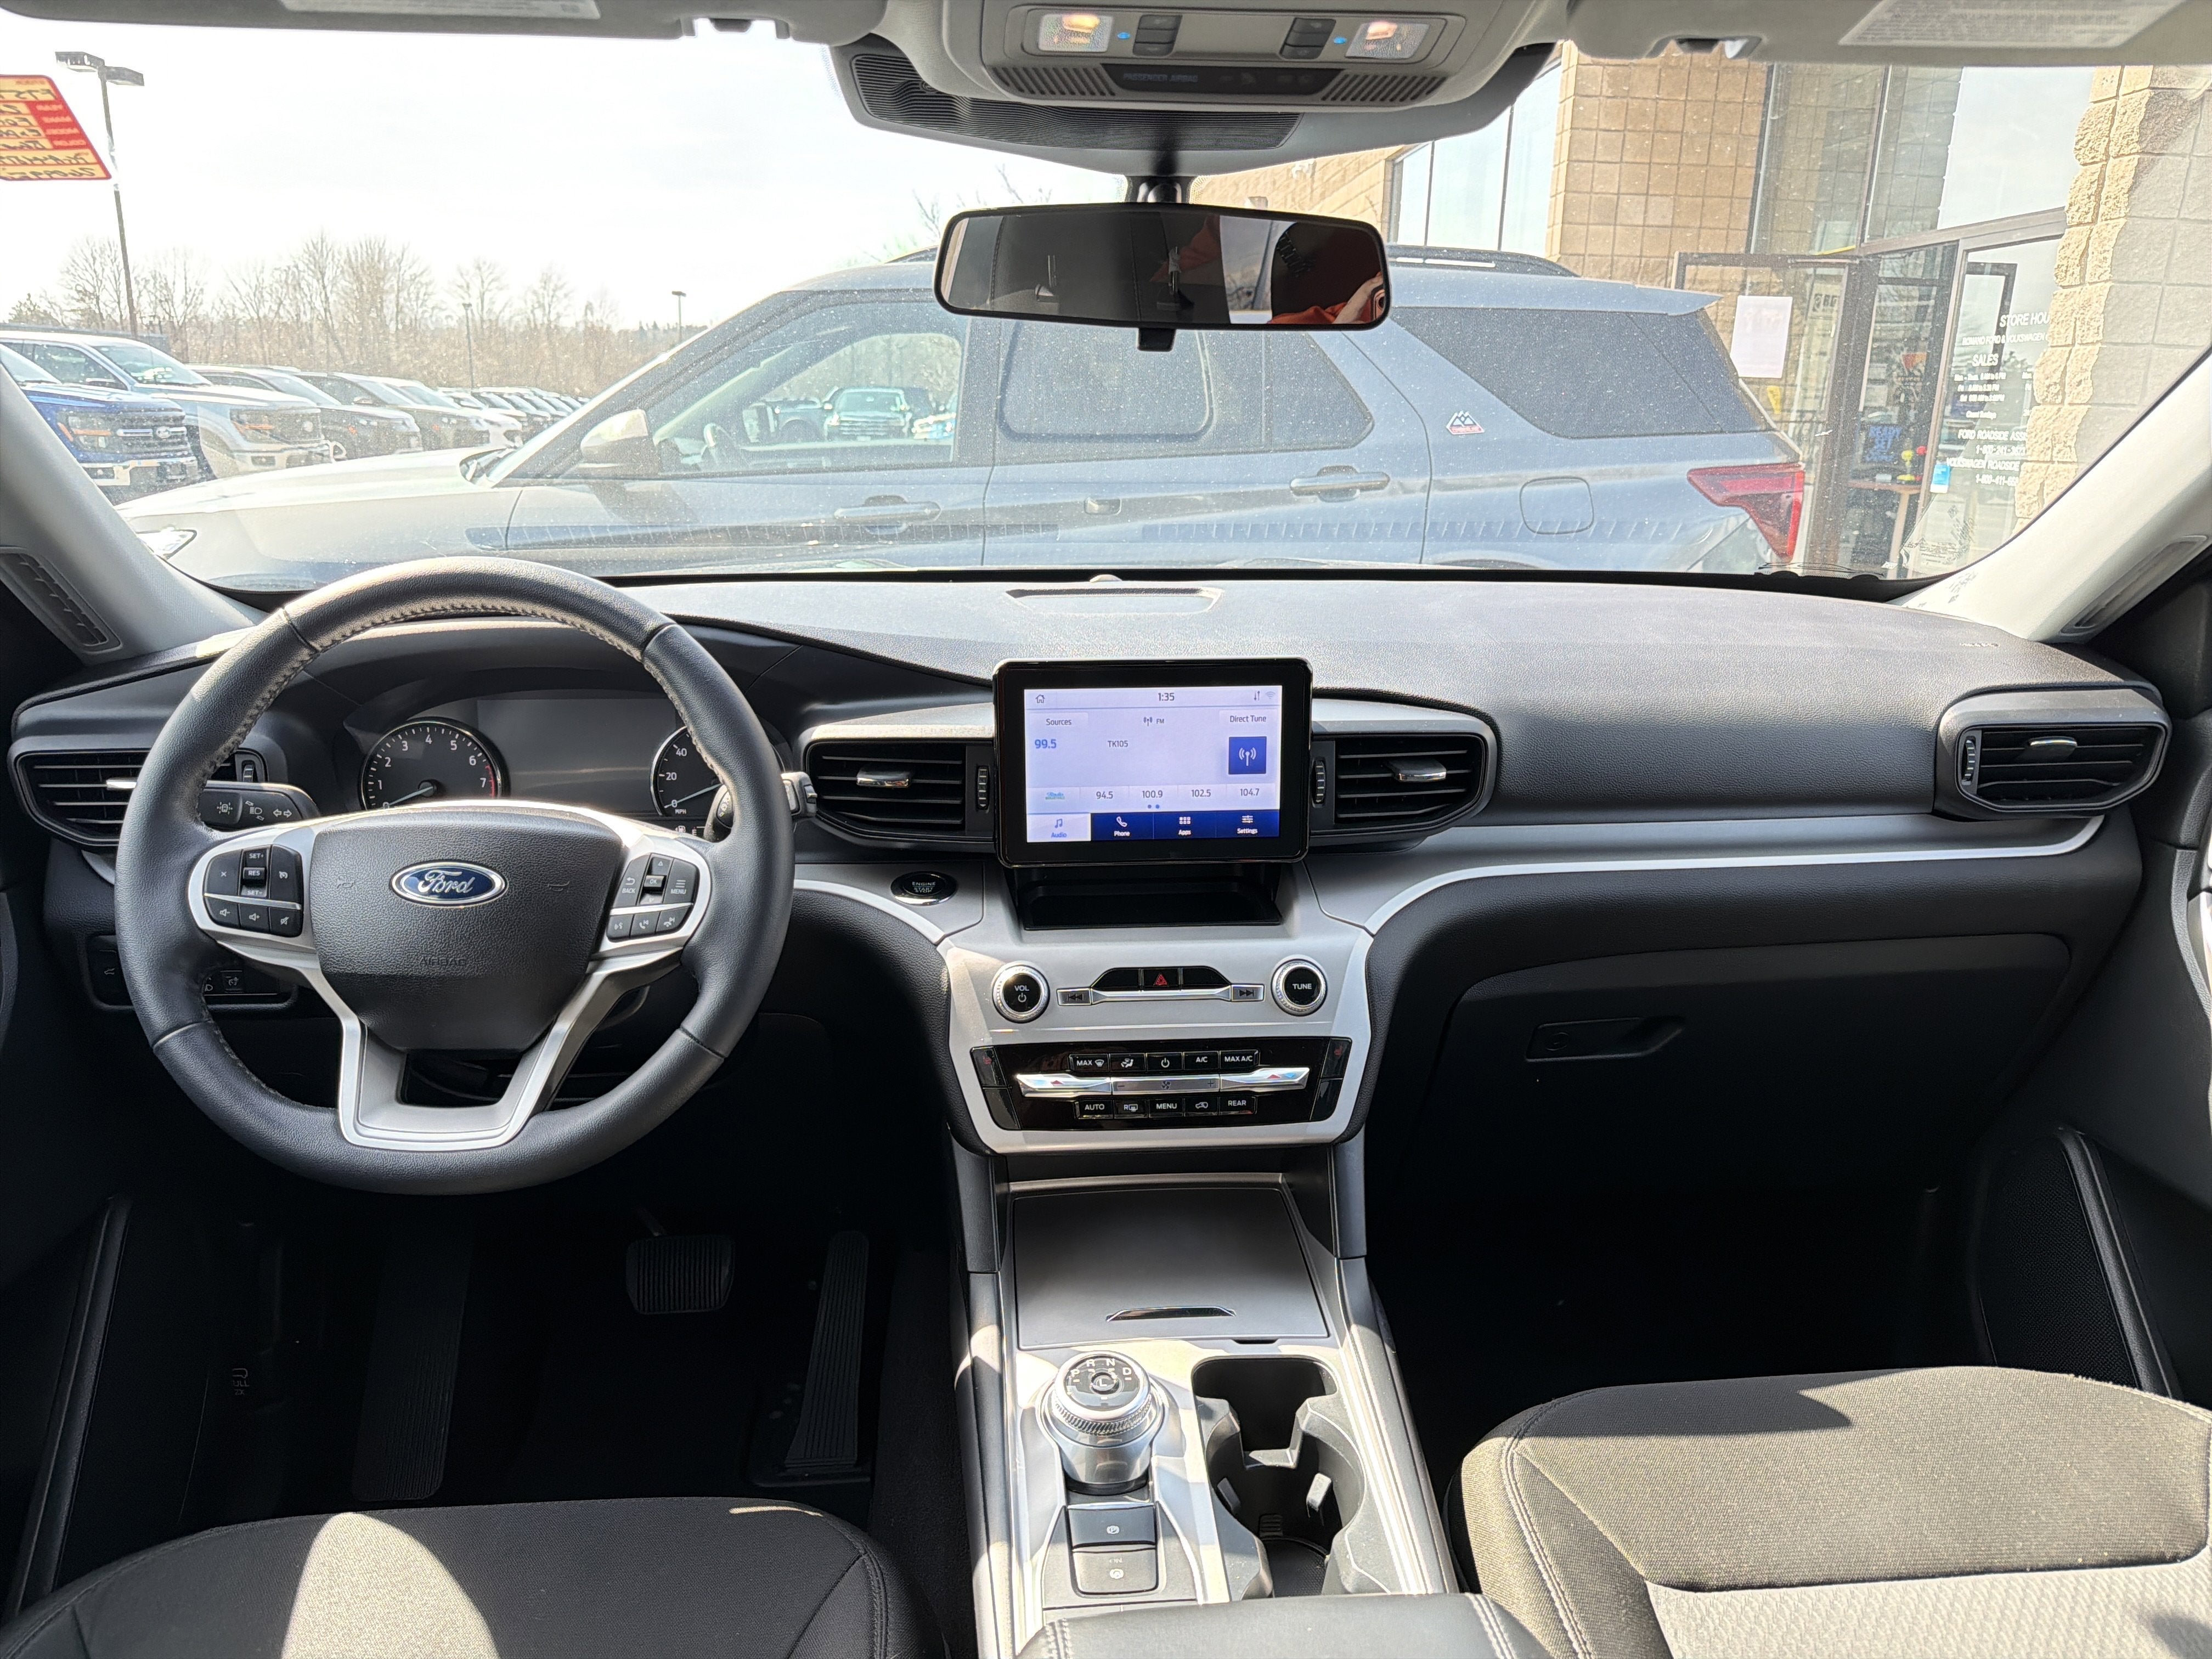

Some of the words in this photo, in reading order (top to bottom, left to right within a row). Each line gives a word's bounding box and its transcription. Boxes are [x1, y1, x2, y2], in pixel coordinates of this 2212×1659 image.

[1124, 73, 1167, 82] PASSENGER
[1170, 74, 1198, 83] AIRBAG
[2000, 313, 2030, 327] STORE
[1986, 335, 2001, 345] FORD
[2006, 332, 2045, 343] VOLKSWAGEN
[1972, 353, 1999, 367] SALES
[1958, 429, 1976, 440] FORD
[1977, 430, 2009, 441] ROADSIDE
[1946, 458, 1987, 469] VOLKSWAGEN
[1988, 460, 2020, 471] ROADSIDE
[1158, 692, 1175, 701] 1:35
[425, 734, 432, 744] 4
[1035, 738, 1057, 749] 99.5
[402, 741, 408, 751] 3
[450, 740, 457, 751] 5
[676, 748, 687, 757] 40
[385, 757, 391, 768] 2
[469, 755, 477, 766] 6
[665, 772, 677, 781] 20
[377, 780, 382, 790] 1
[479, 777, 487, 788] 7
[1096, 791, 1113, 799] 94.5
[1142, 790, 1163, 798] 100.9
[1192, 789, 1211, 797] 102.5
[1240, 788, 1260, 796] 104.7
[671, 799, 678, 808] 0
[417, 870, 476, 894] Ford
[419, 956, 467, 966] AIRBAG
[1086, 1359, 1096, 1367] R
[1106, 1358, 1115, 1367] N
[1070, 1368, 1080, 1378] P
[1122, 1367, 1132, 1375] D
[1099, 1378, 1108, 1387] L
